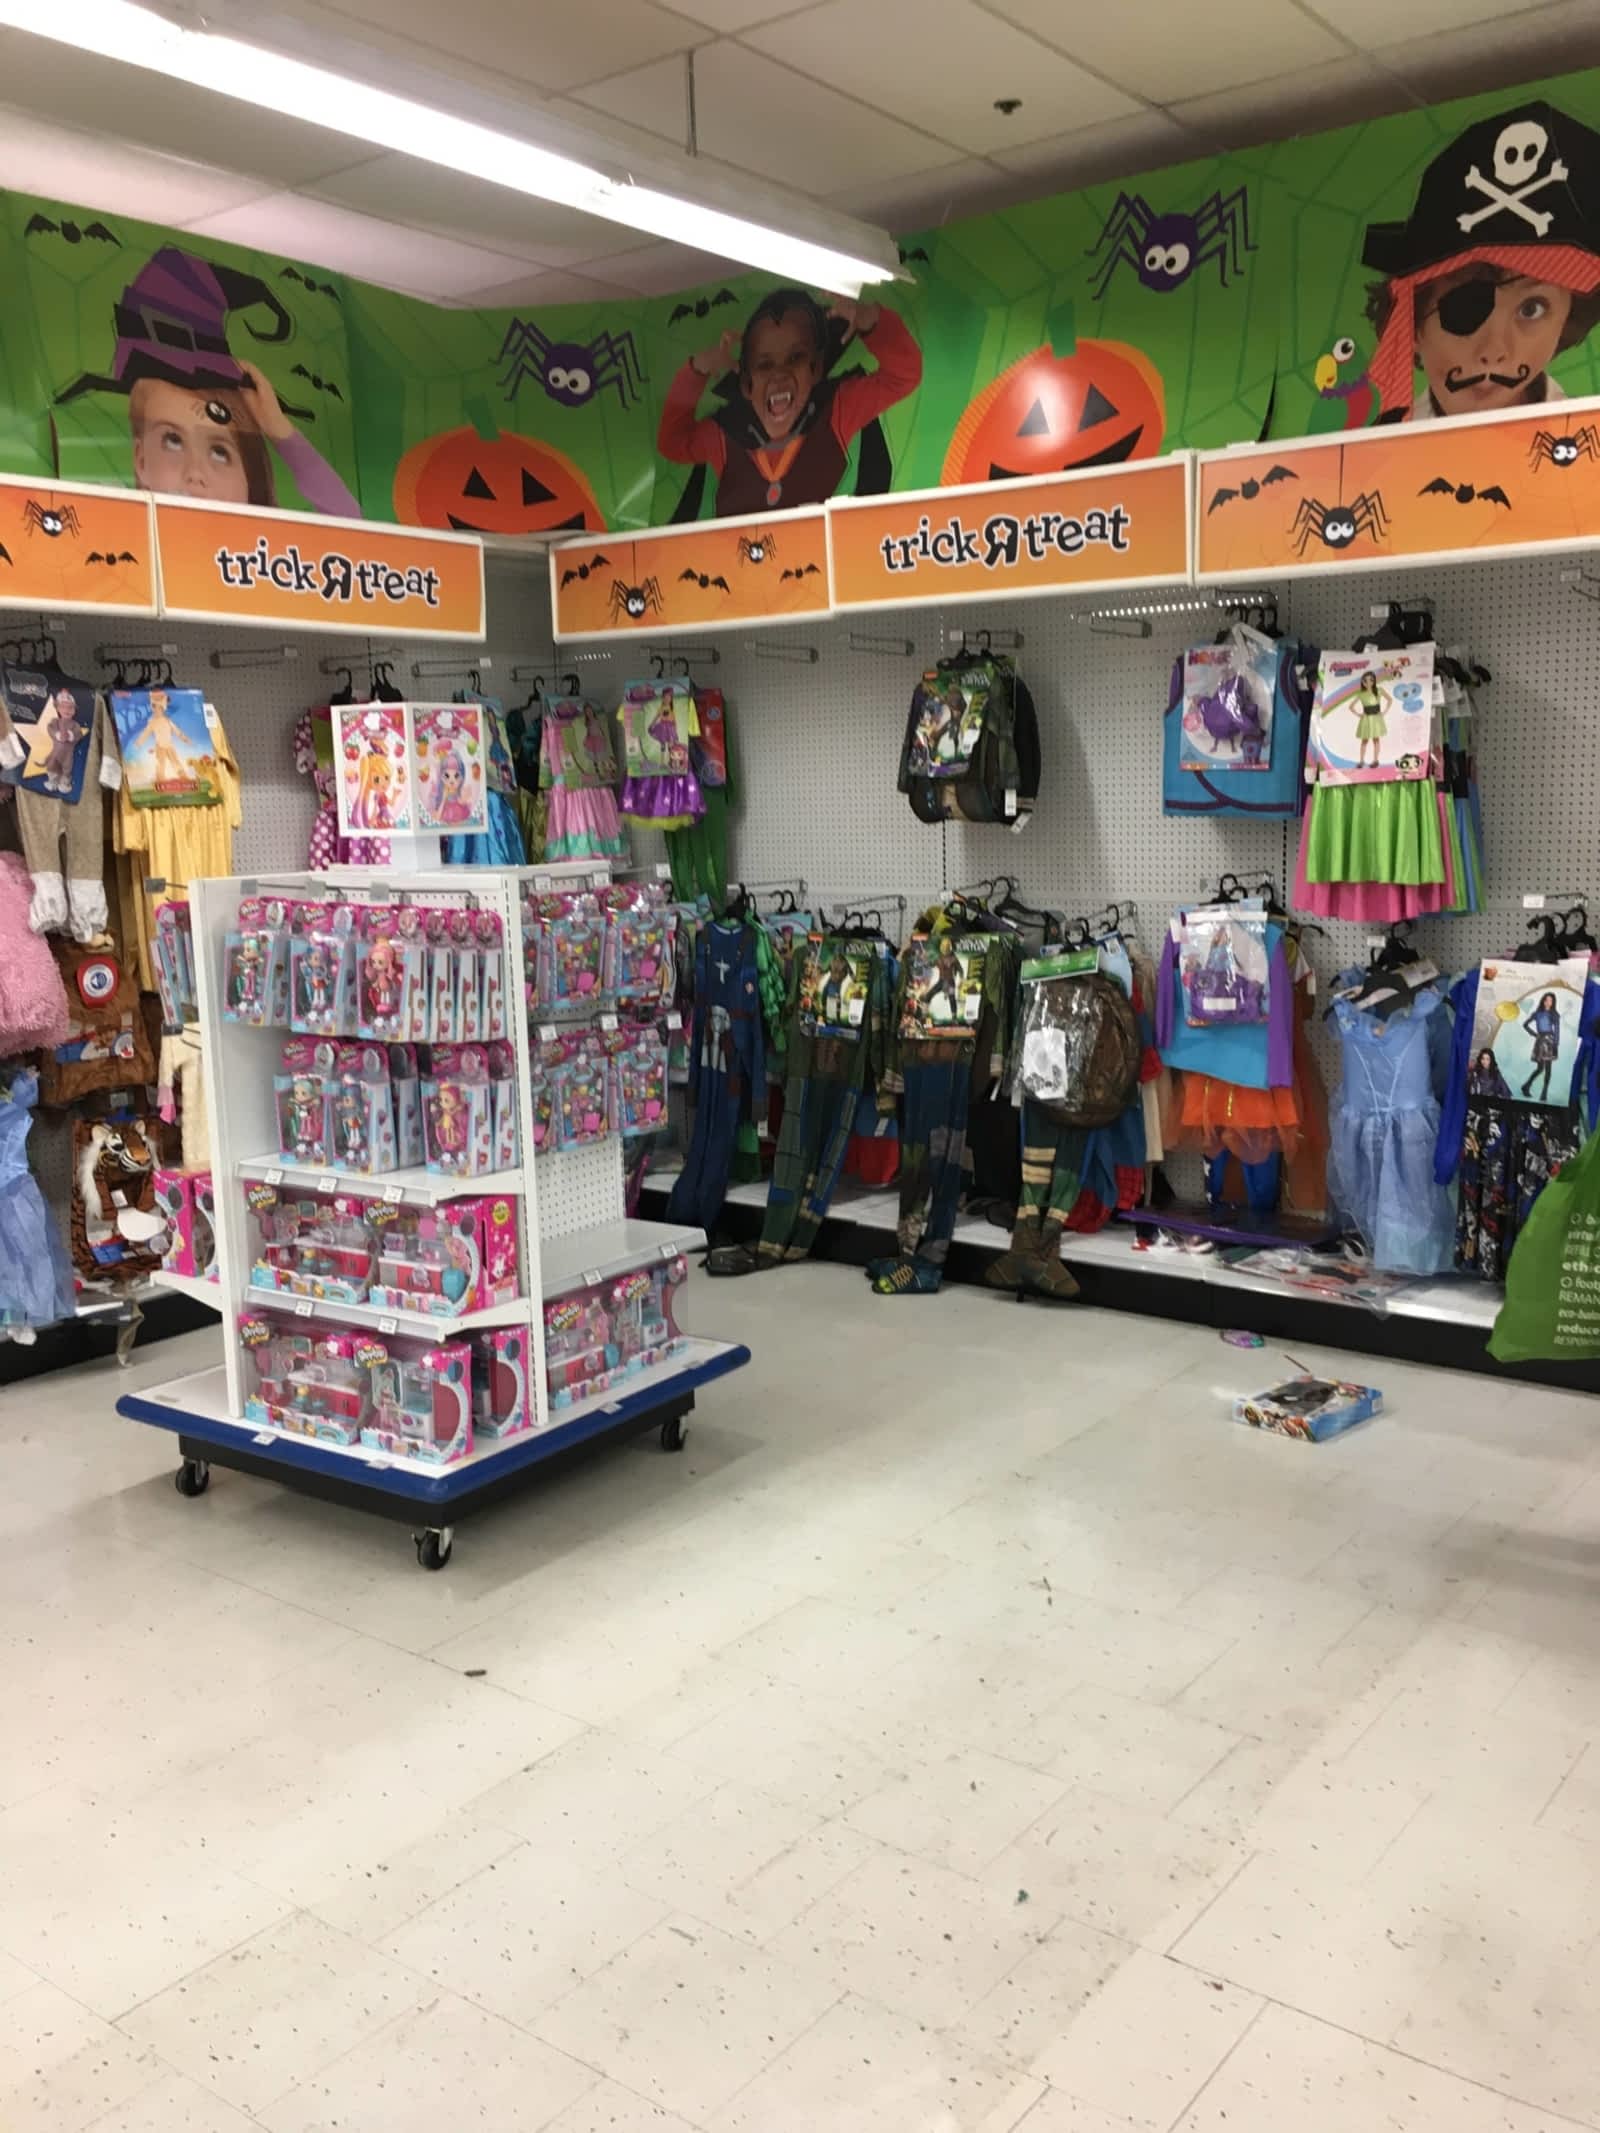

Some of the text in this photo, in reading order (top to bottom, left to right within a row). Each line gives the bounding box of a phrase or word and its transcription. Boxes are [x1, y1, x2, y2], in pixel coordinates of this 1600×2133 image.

[880, 516, 980, 571] trick
[1022, 506, 1130, 559] treat
[217, 538, 317, 591] trick
[355, 562, 439, 606] treat
